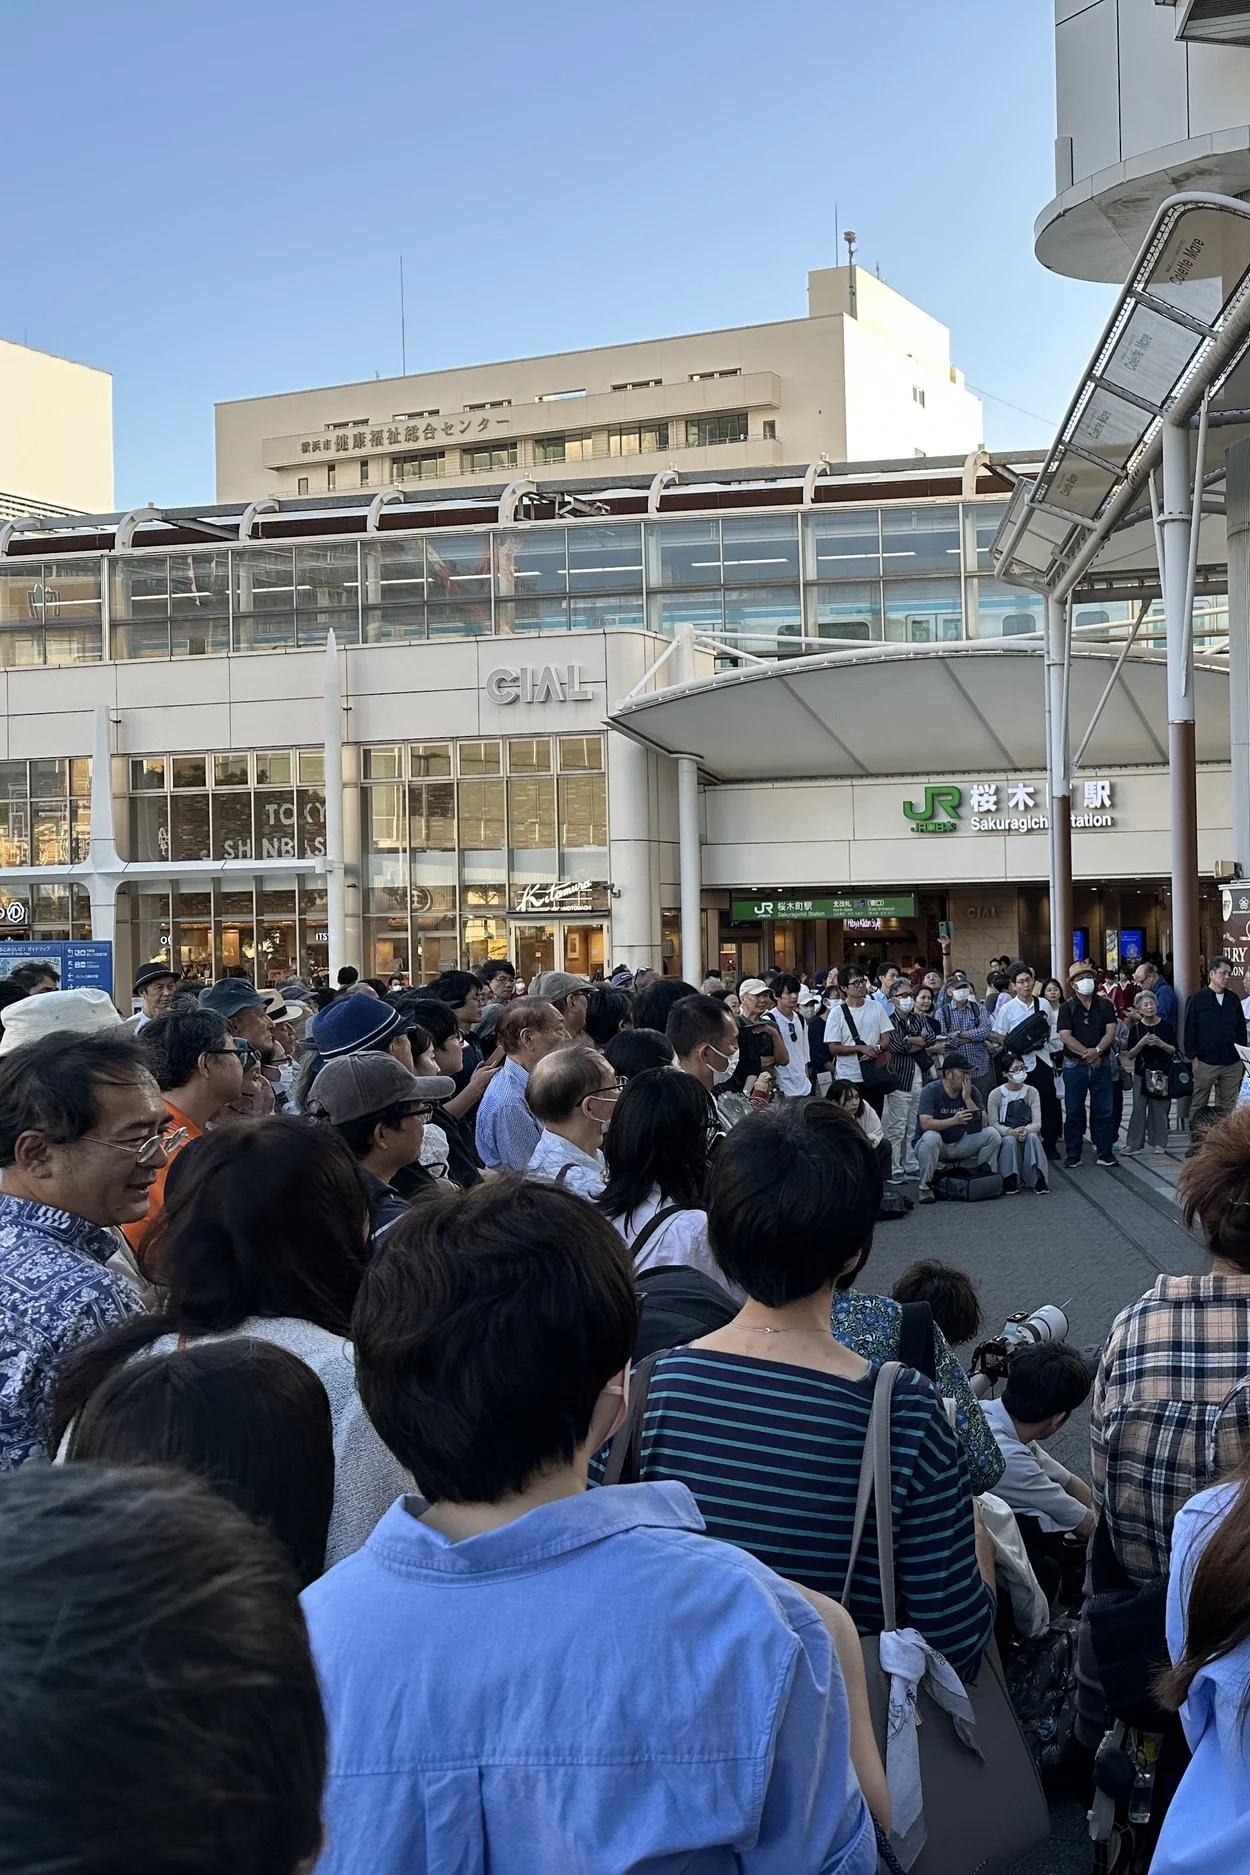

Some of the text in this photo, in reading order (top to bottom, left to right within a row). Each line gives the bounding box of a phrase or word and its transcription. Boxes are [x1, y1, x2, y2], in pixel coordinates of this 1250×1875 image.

[1169, 259, 1193, 286] Colette
[1183, 238, 1205, 260] Mare
[486, 665, 593, 704] CIAL
[903, 785, 962, 821] JR
[970, 780, 1112, 812] 桜木駅
[265, 803, 326, 825] TOKY
[971, 813, 1112, 832] Sakuragich tation
[516, 880, 592, 912] Kitamura
[754, 902, 774, 914] JR
[777, 901, 813, 911] 桜木町駅
[967, 906, 1000, 919] CIAL
